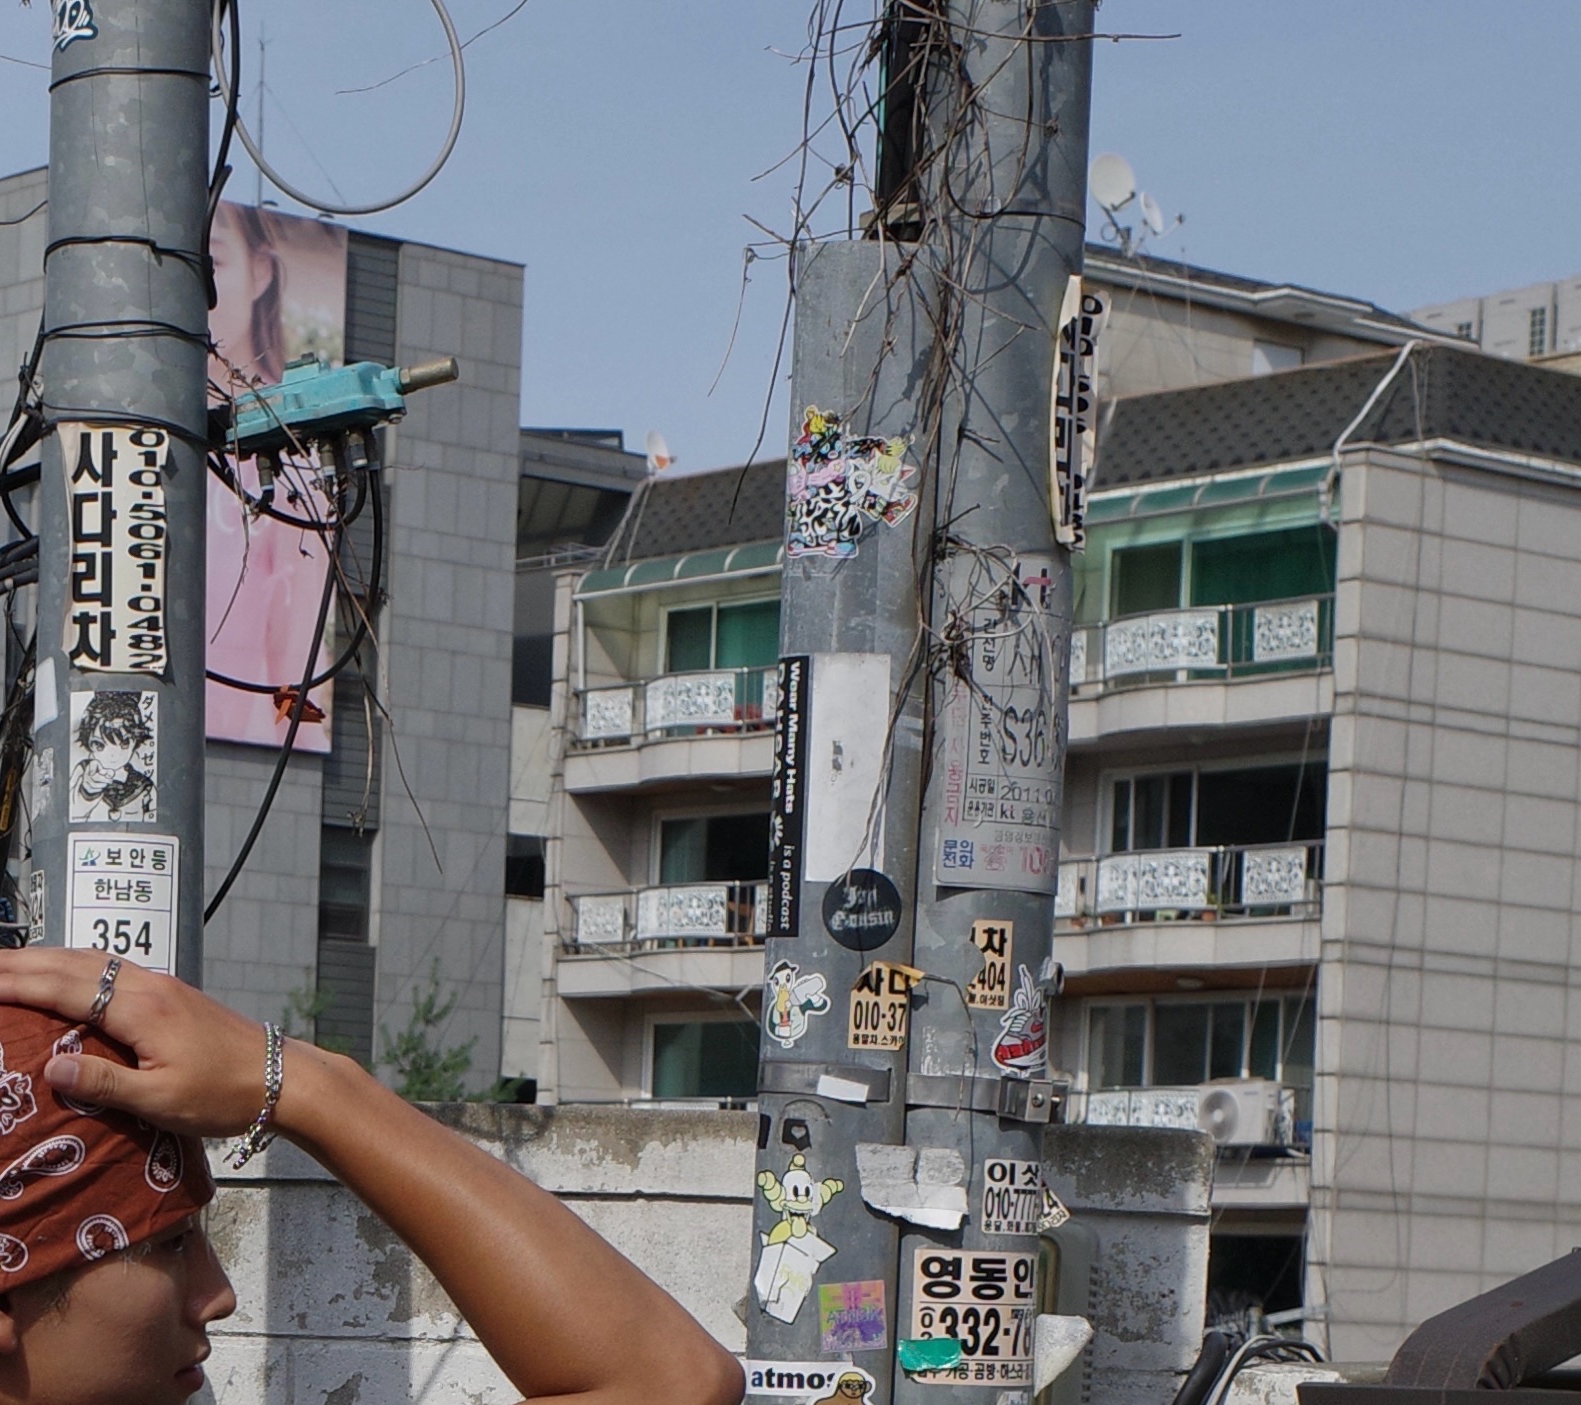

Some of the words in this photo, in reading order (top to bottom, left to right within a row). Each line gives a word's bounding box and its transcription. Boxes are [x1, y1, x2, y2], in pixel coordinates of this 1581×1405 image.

[69, 431, 118, 667] 사다리차
[788, 661, 801, 711] Wear
[785, 713, 799, 767] Many
[784, 768, 797, 814] Hats
[105, 848, 168, 871] 보안등
[783, 844, 795, 857] is
[783, 859, 792, 868] a
[943, 853, 975, 870] 전화
[94, 878, 153, 903] 한남동
[779, 871, 793, 931] podcast
[92, 918, 153, 956] 354
